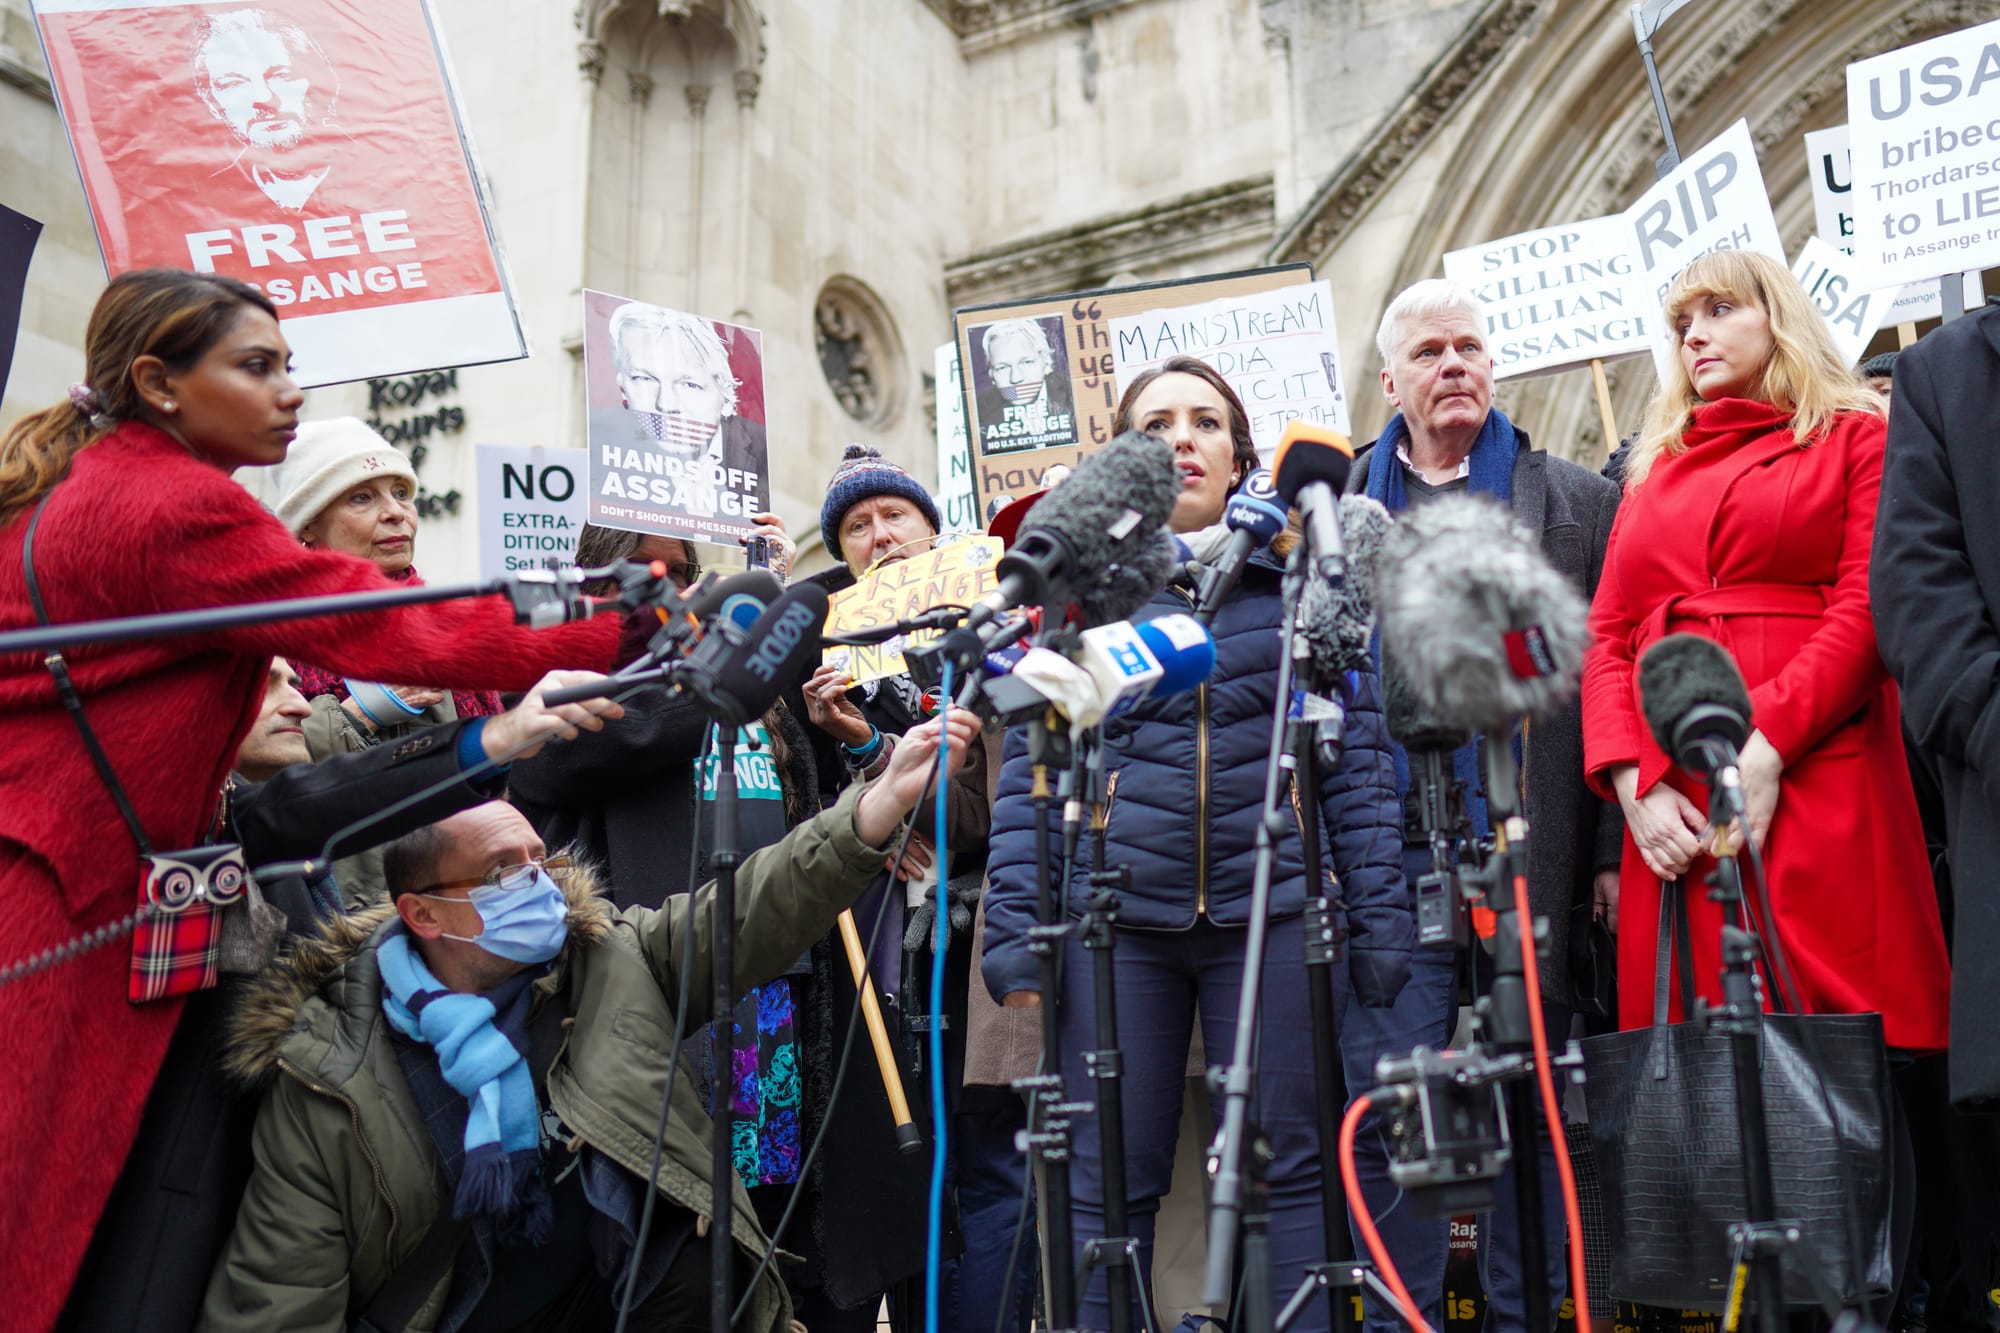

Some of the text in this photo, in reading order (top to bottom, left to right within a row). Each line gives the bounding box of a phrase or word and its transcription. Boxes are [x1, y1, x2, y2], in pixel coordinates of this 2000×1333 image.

[1634, 151, 1738, 272] RIP
[1882, 212, 1921, 239] to
[185, 210, 417, 274] FREE
[1482, 232, 1581, 272] STOP
[1882, 252, 1897, 264] In
[1904, 232, 1981, 260] Assange
[247, 262, 427, 307] SANGE
[1471, 254, 1632, 306] KILLING
[1119, 292, 1323, 363] MAINSTREAM
[1487, 287, 1624, 336] JULIAN
[1494, 316, 1649, 368] SSANG
[366, 368, 459, 412] Royal
[366, 405, 465, 445] ourts
[986, 413, 1072, 440] ASSANGE
[1003, 402, 1049, 422] FREE
[987, 441, 1000, 450] NO
[1017, 431, 1072, 446] EXTRADITION
[502, 463, 575, 502] NO
[602, 444, 758, 492] HANDS OFF
[600, 471, 760, 518] ASSANGE
[503, 512, 576, 530] EXTRA-
[600, 504, 753, 536] DON'T SHOOT THE MESSENG
[503, 534, 576, 551] DITION!
[505, 555, 577, 571] Set hm
[1448, 1290, 1476, 1321] is
[1680, 1321, 1716, 1333] rwell
